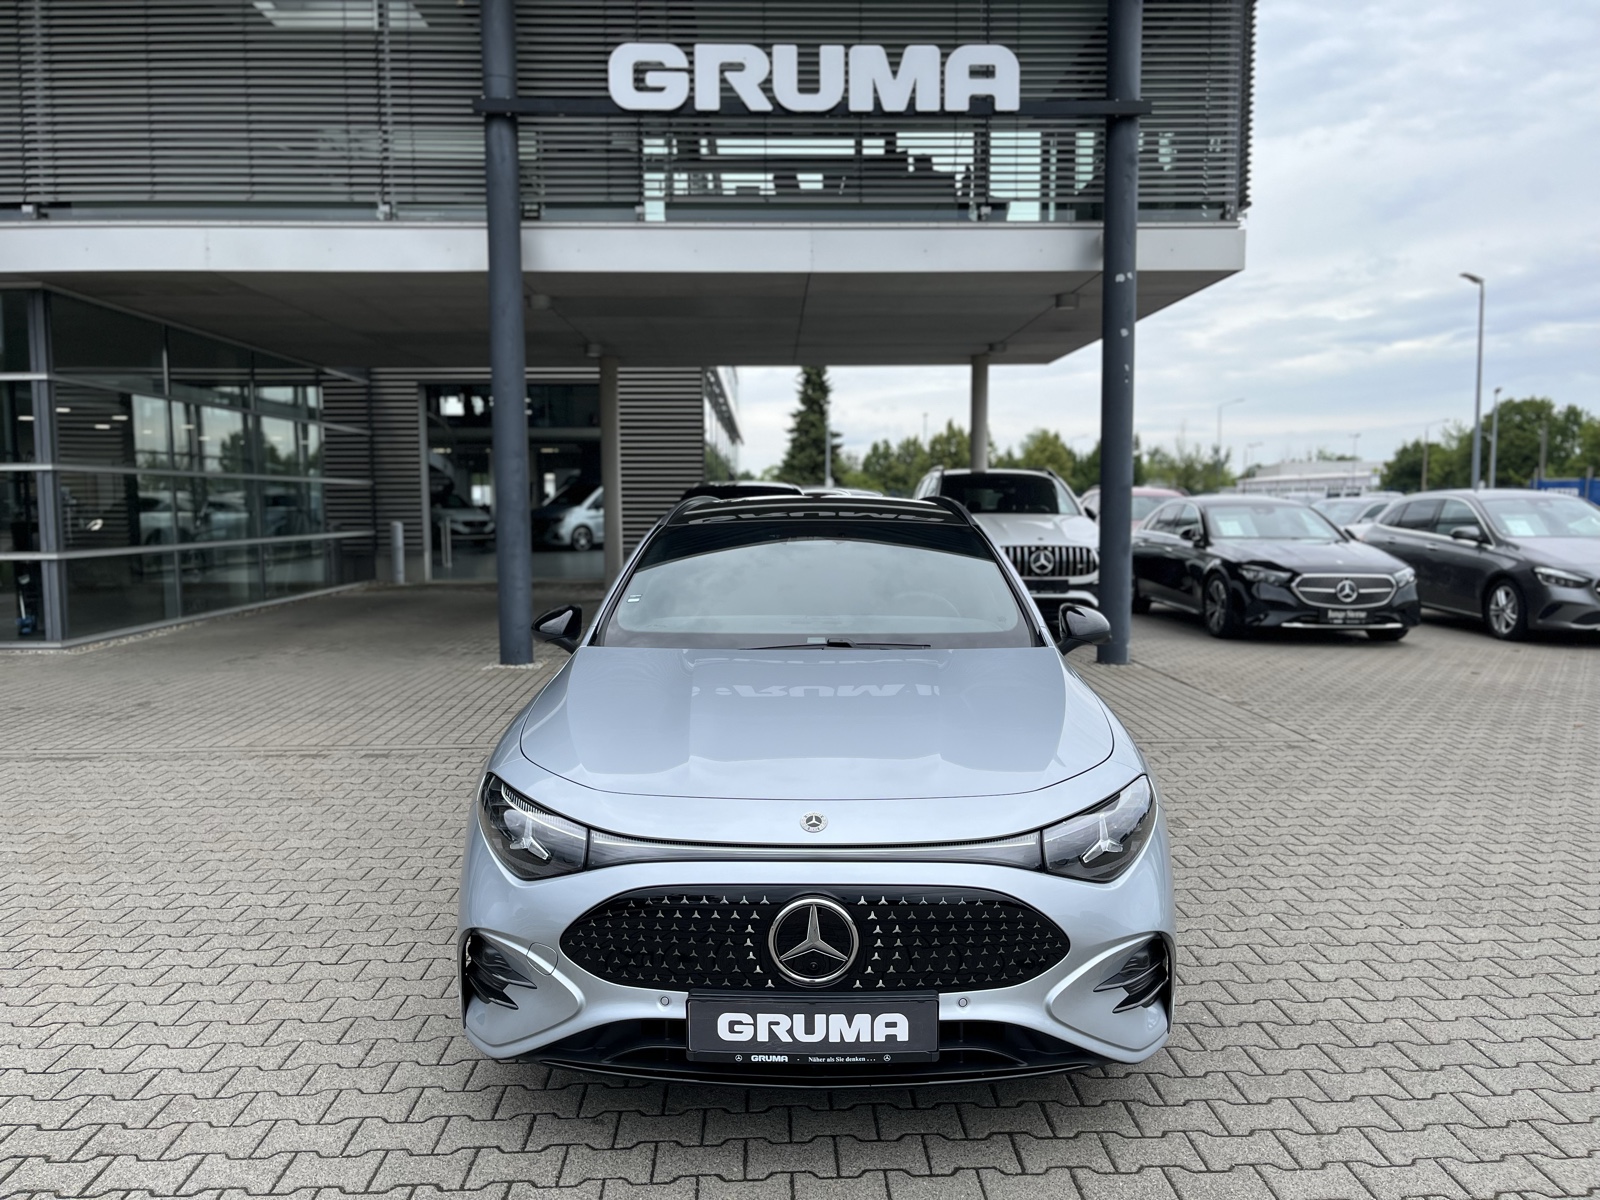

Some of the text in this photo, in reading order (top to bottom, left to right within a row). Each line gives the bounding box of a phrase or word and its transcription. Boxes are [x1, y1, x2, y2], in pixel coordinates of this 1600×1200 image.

[608, 43, 1020, 112] GRUMA
[717, 1012, 909, 1043] GRUMA
[750, 1054, 789, 1063] GRUMA
